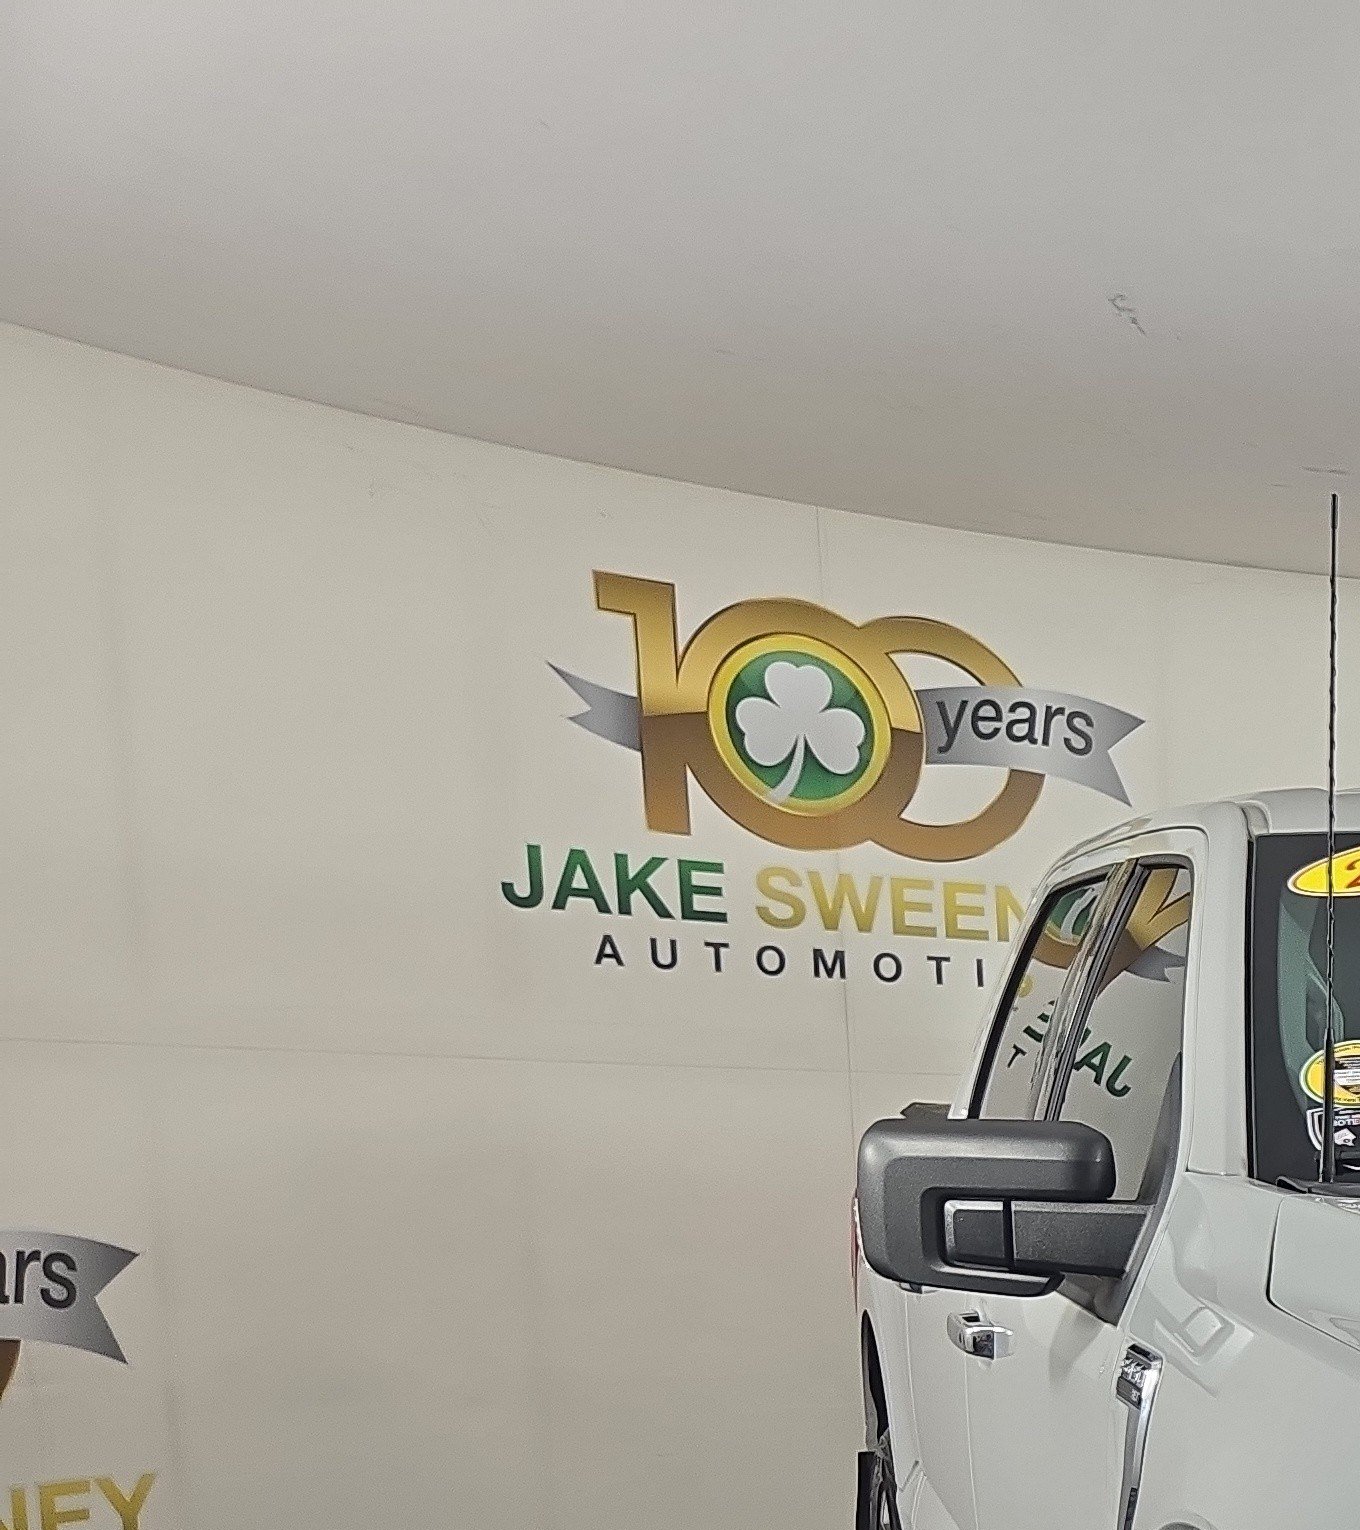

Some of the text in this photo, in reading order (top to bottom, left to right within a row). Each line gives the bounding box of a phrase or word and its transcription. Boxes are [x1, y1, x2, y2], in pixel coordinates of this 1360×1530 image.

[935, 698, 1094, 756] years
[501, 844, 1026, 942] JAKE SWEEN
[594, 934, 984, 988] AUTOMOTI
